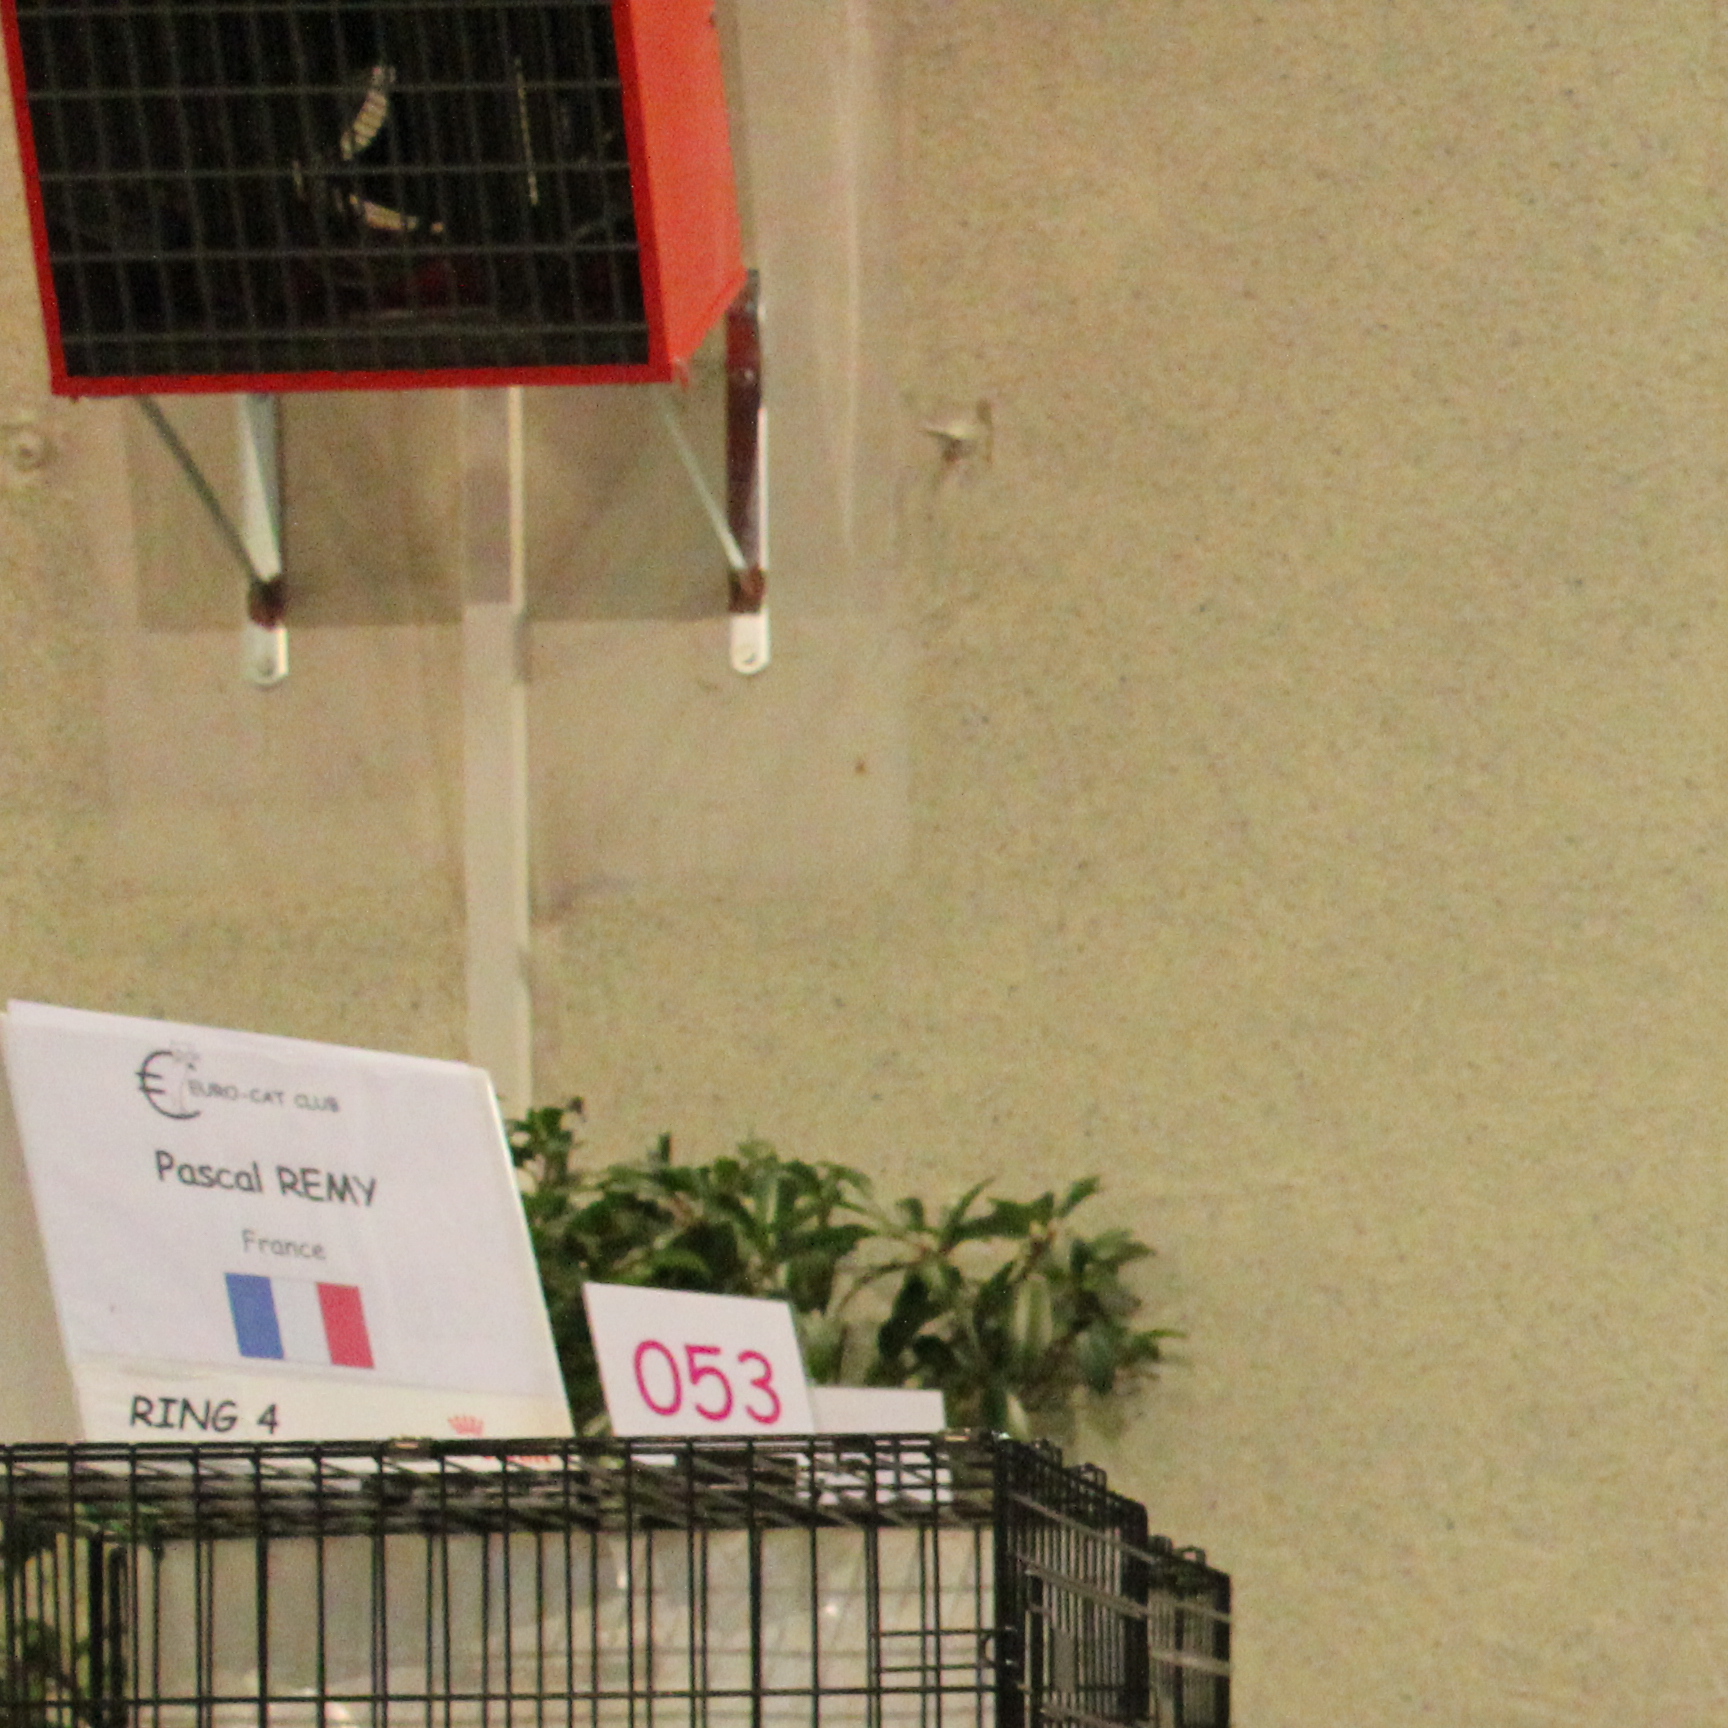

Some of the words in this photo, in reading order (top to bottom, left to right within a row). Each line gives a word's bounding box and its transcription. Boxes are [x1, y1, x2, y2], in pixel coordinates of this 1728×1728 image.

[294, 1092, 341, 1113] CLUB
[155, 1149, 264, 1193] Pascal
[275, 1165, 377, 1207] REMY
[241, 1228, 327, 1261] France
[633, 1338, 782, 1425] 053
[129, 1394, 239, 1433] RING
[256, 1402, 279, 1435] 4
